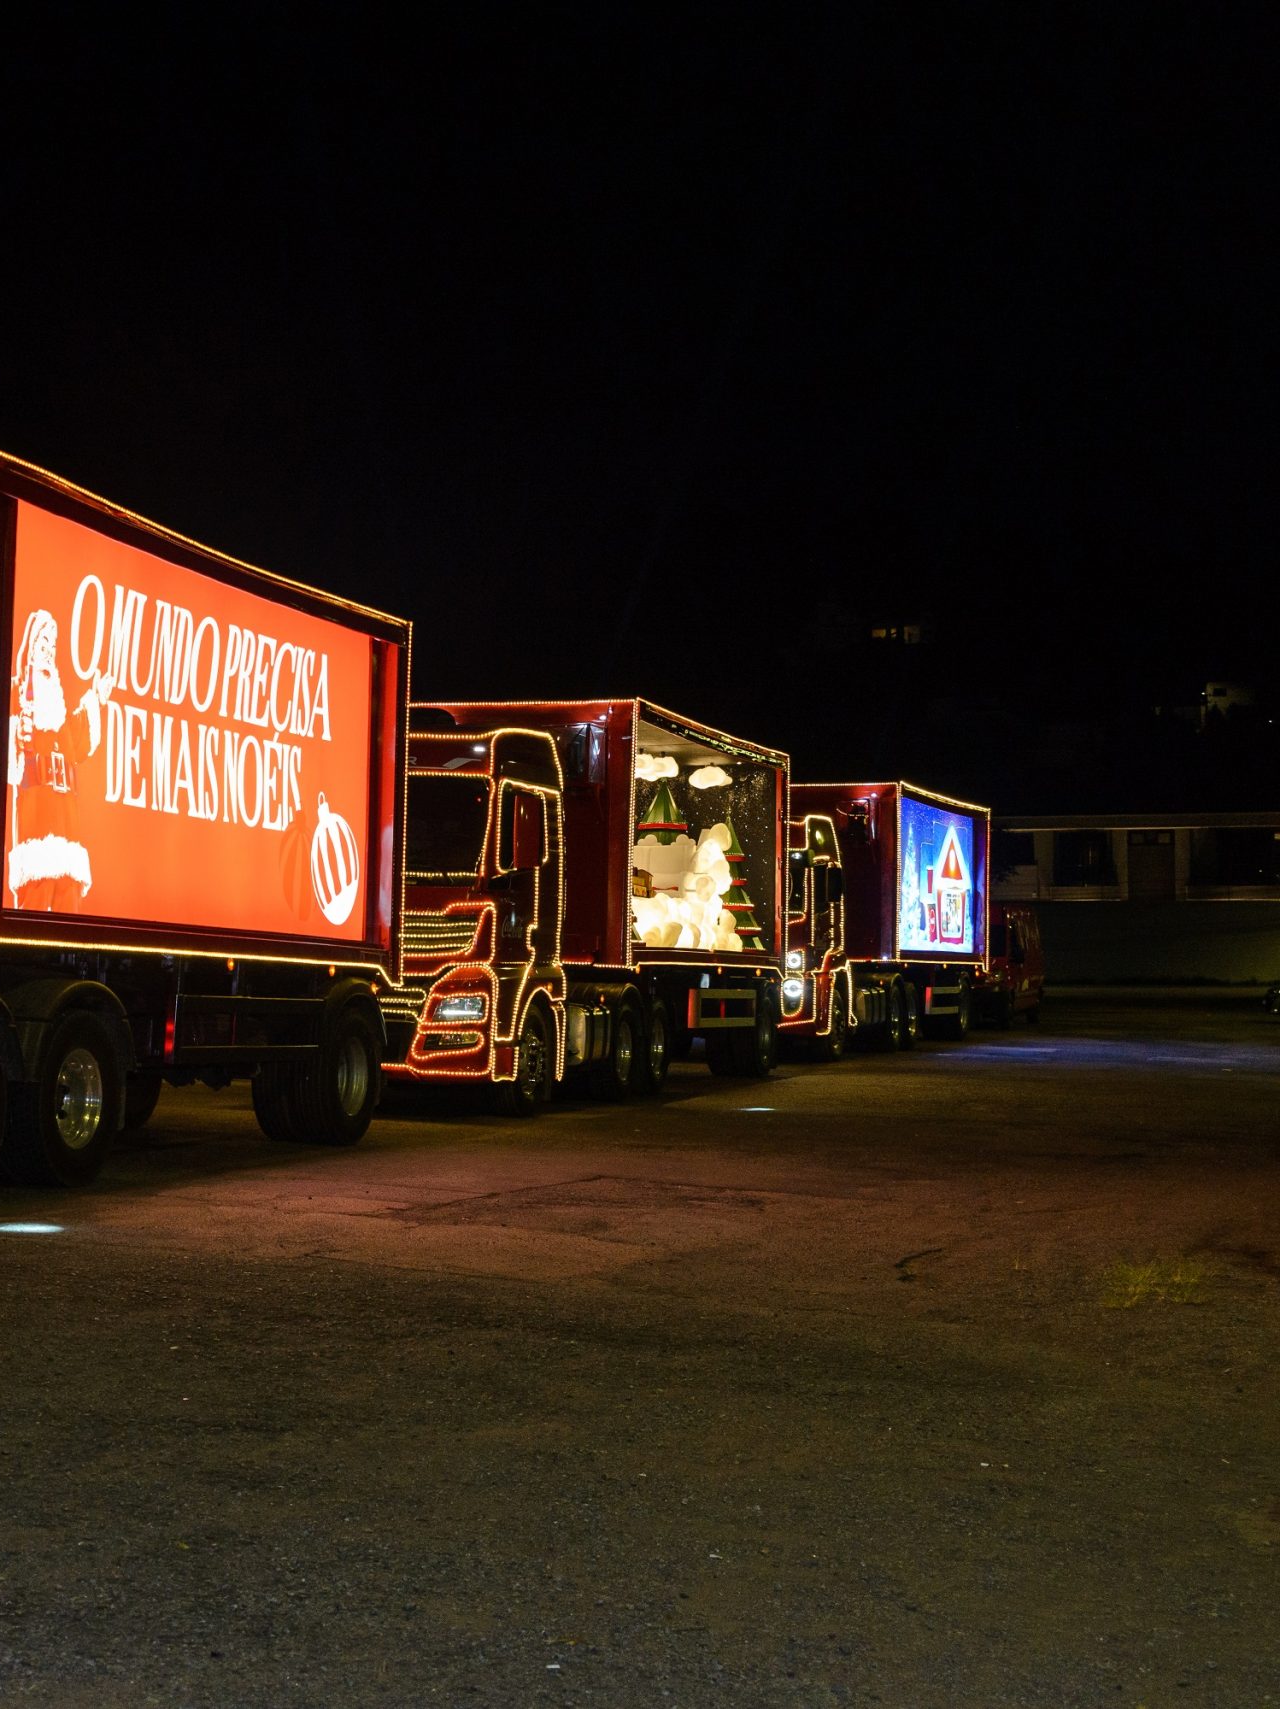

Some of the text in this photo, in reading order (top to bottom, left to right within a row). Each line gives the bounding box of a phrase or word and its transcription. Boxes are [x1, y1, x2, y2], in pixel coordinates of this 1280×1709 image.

[70, 574, 332, 742] O MUNDO PRECISA
[104, 699, 303, 832] DE MAIS NOÉIS
